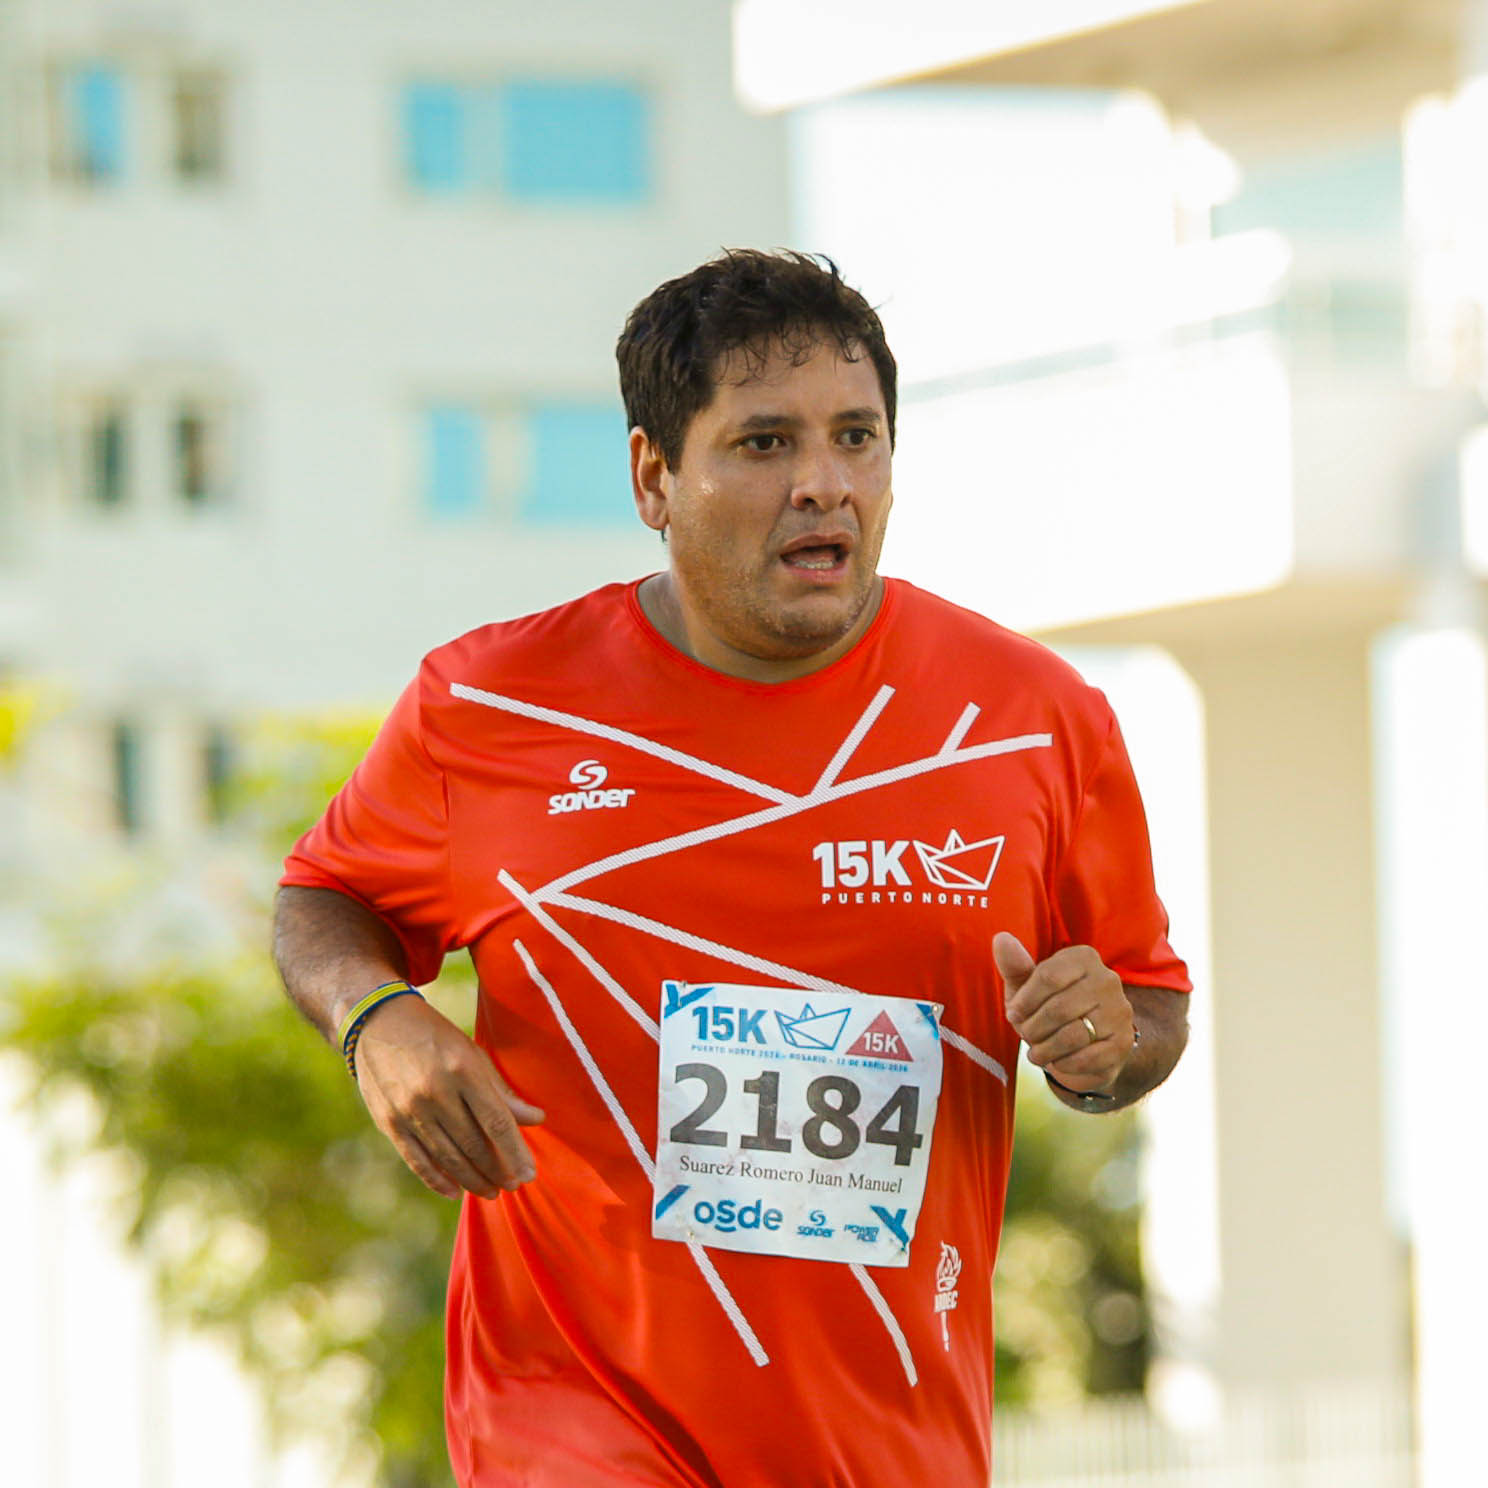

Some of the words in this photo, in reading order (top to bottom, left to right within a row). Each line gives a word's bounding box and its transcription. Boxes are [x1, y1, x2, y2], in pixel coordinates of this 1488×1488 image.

[812, 840, 913, 888] 15K
[821, 890, 913, 905] PUERTO
[922, 892, 989, 909] NORTE
[692, 1005, 769, 1045] 15K
[863, 1031, 901, 1055] 15K
[670, 1062, 923, 1167] 2184
[679, 1154, 734, 1176] Suarez
[741, 1161, 803, 1182] Romero
[808, 1168, 842, 1187] Juan
[847, 1173, 903, 1194] Manuel
[694, 1199, 784, 1231] osde
